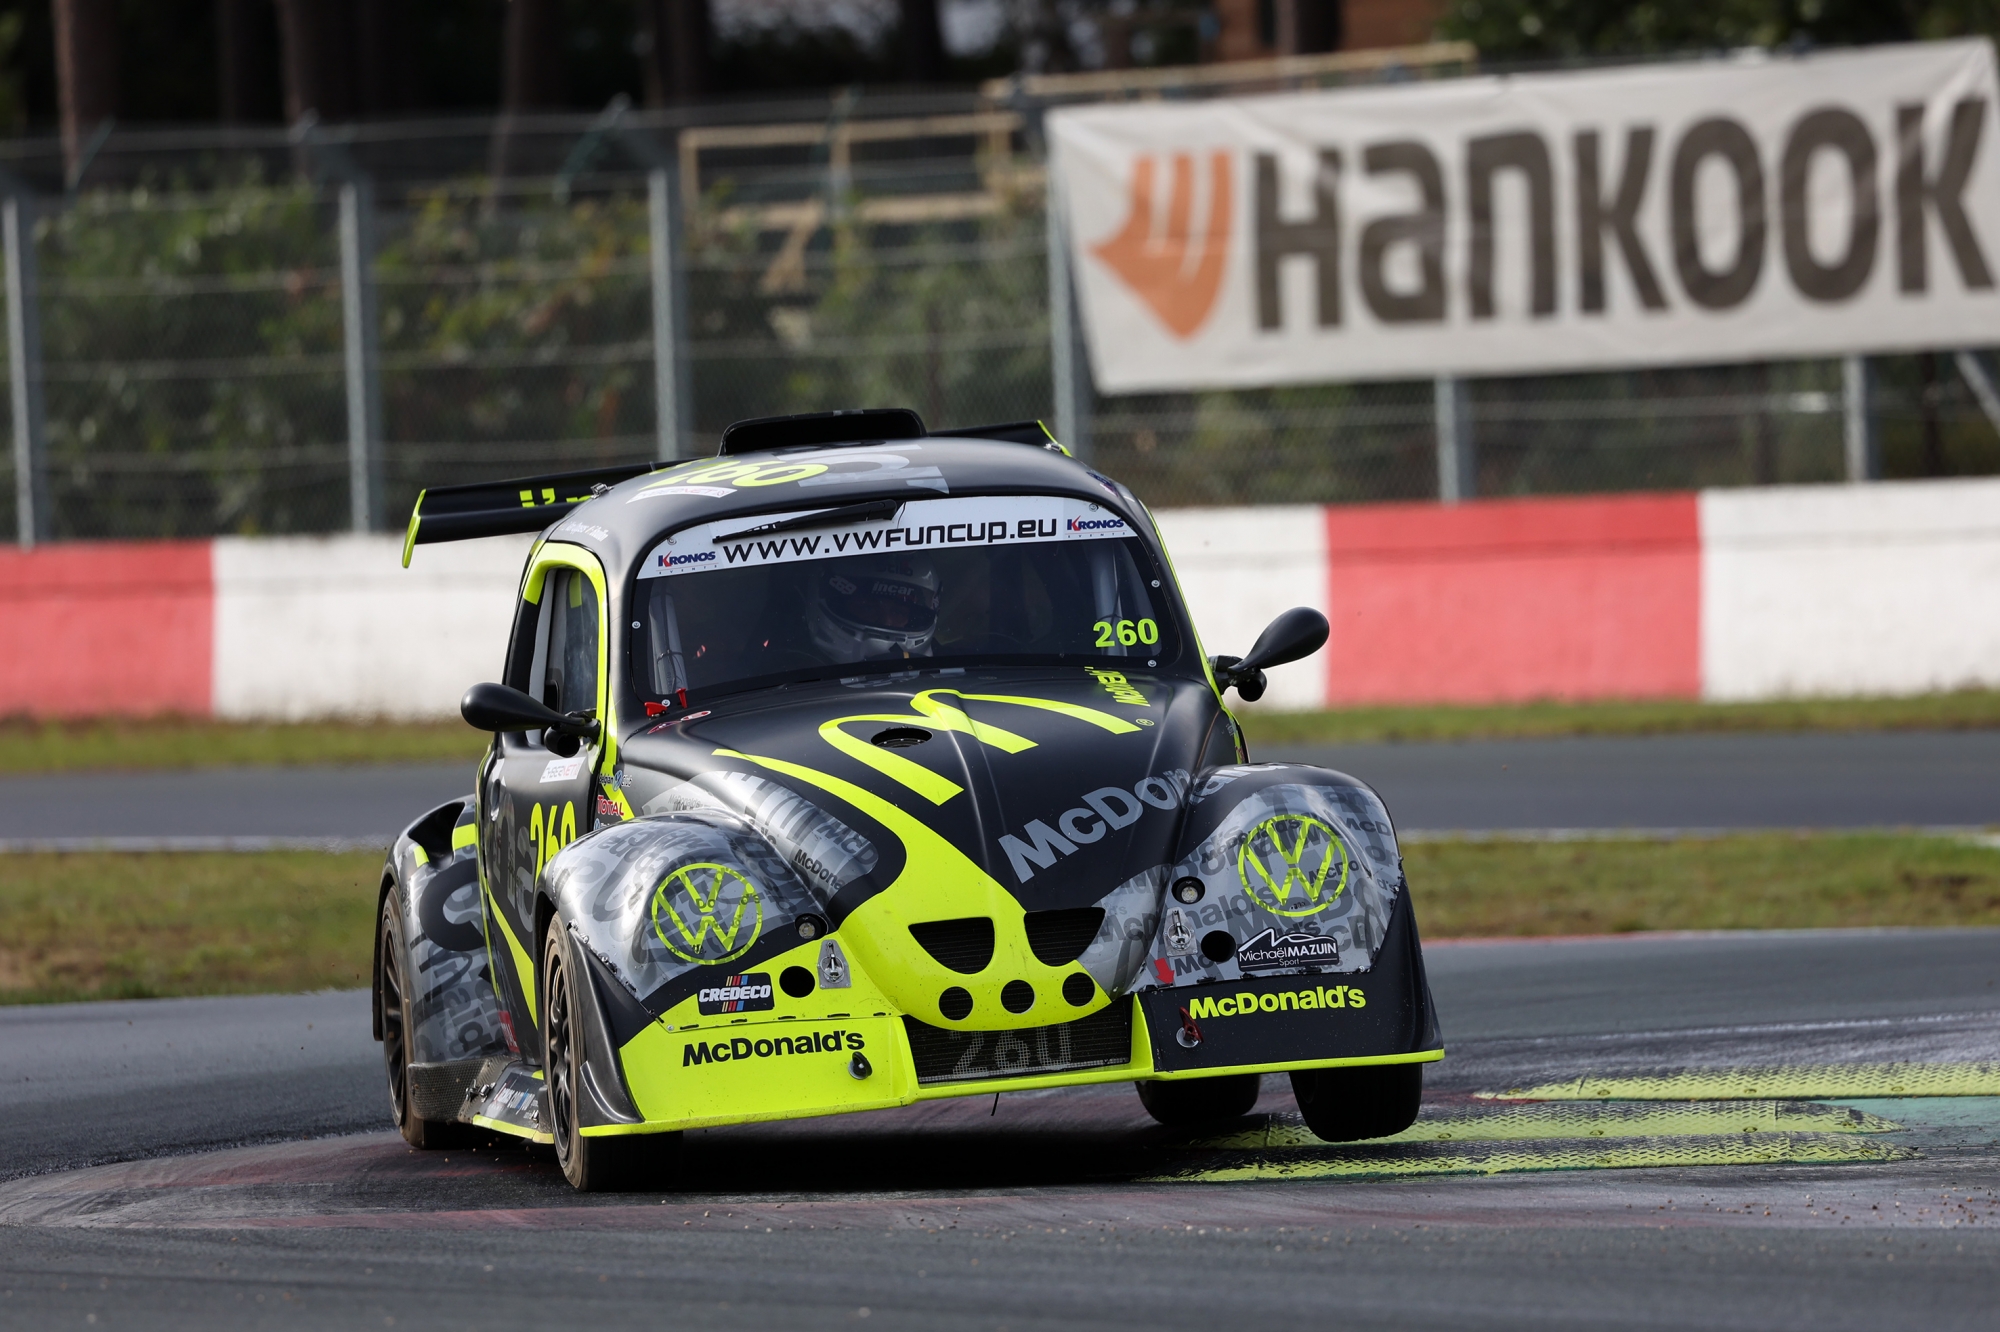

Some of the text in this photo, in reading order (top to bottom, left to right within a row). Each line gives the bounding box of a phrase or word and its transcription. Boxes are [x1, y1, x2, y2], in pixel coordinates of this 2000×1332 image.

[1066, 515, 1125, 532] KRONOS
[657, 550, 716, 567] KRONOS
[1092, 618, 1159, 648] 260
[596, 794, 625, 817] TOTAL
[1278, 958, 1300, 968] Sport
[699, 984, 771, 1003] CREDECO
[1189, 985, 1367, 1020] McDonald's
[682, 1030, 866, 1067] McDonald's
